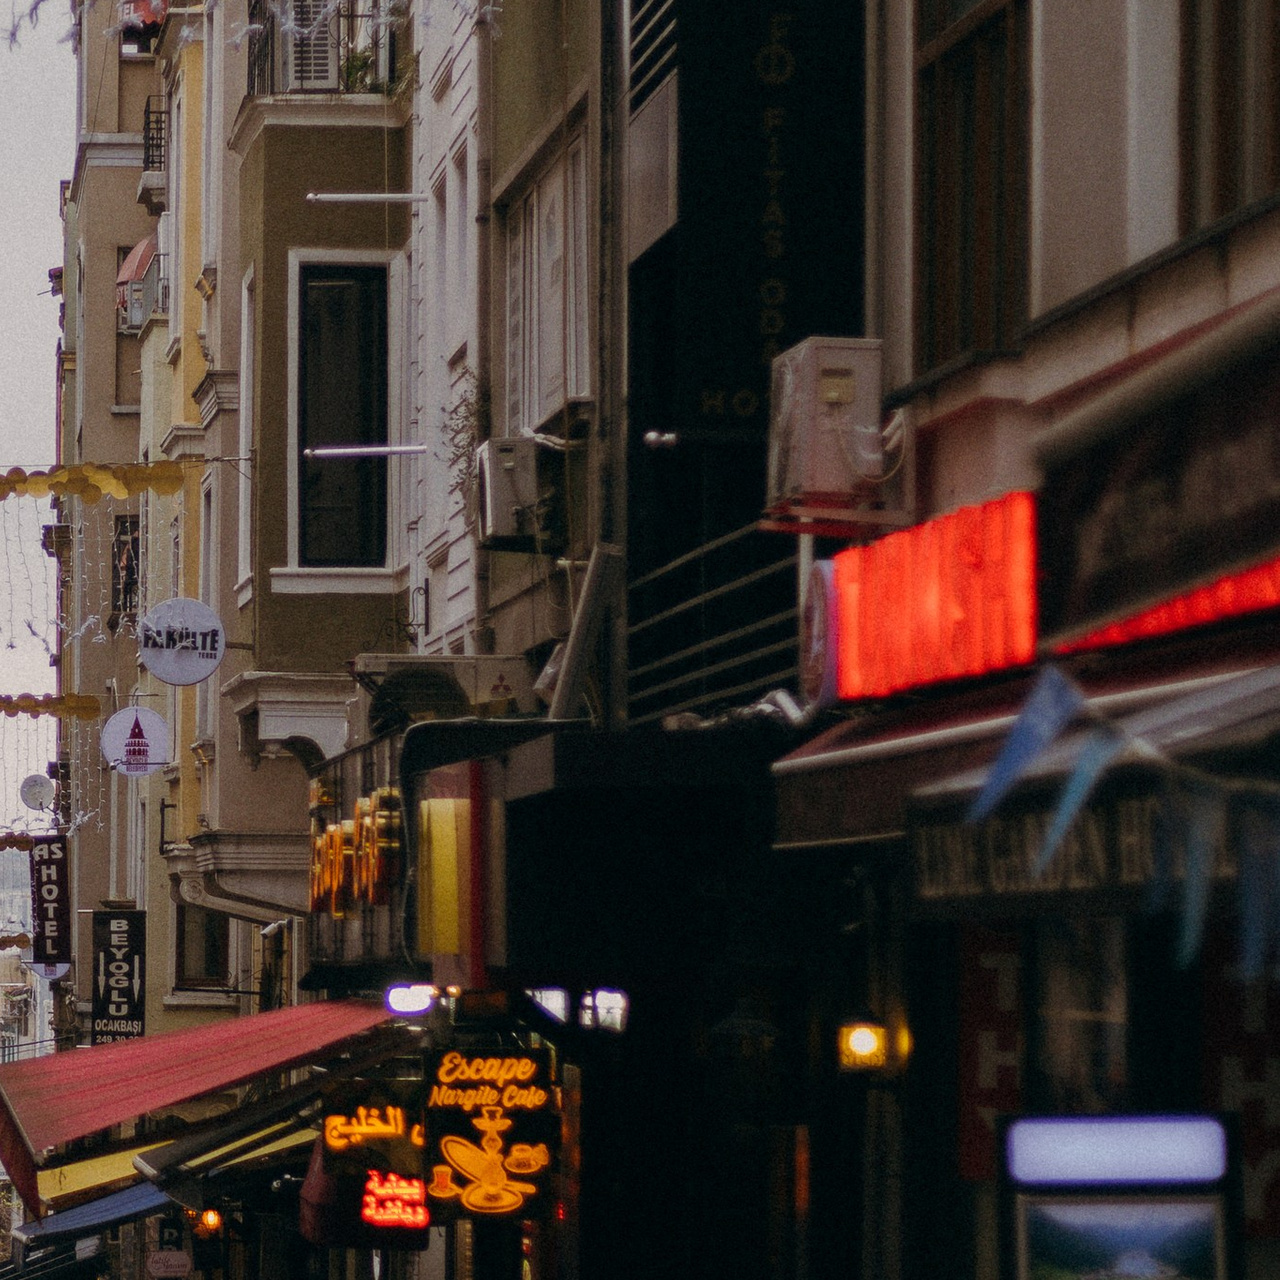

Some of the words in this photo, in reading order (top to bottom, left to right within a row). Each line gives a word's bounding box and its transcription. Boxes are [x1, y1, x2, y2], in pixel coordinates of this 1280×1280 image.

[33, 843, 63, 861] AS
[41, 865, 59, 955] HOTEL
[95, 1019, 142, 1035] OCAKBAŞI
[438, 1052, 536, 1087] Escape
[429, 1085, 500, 1111] Nargile
[502, 1085, 547, 1108] Cafe
